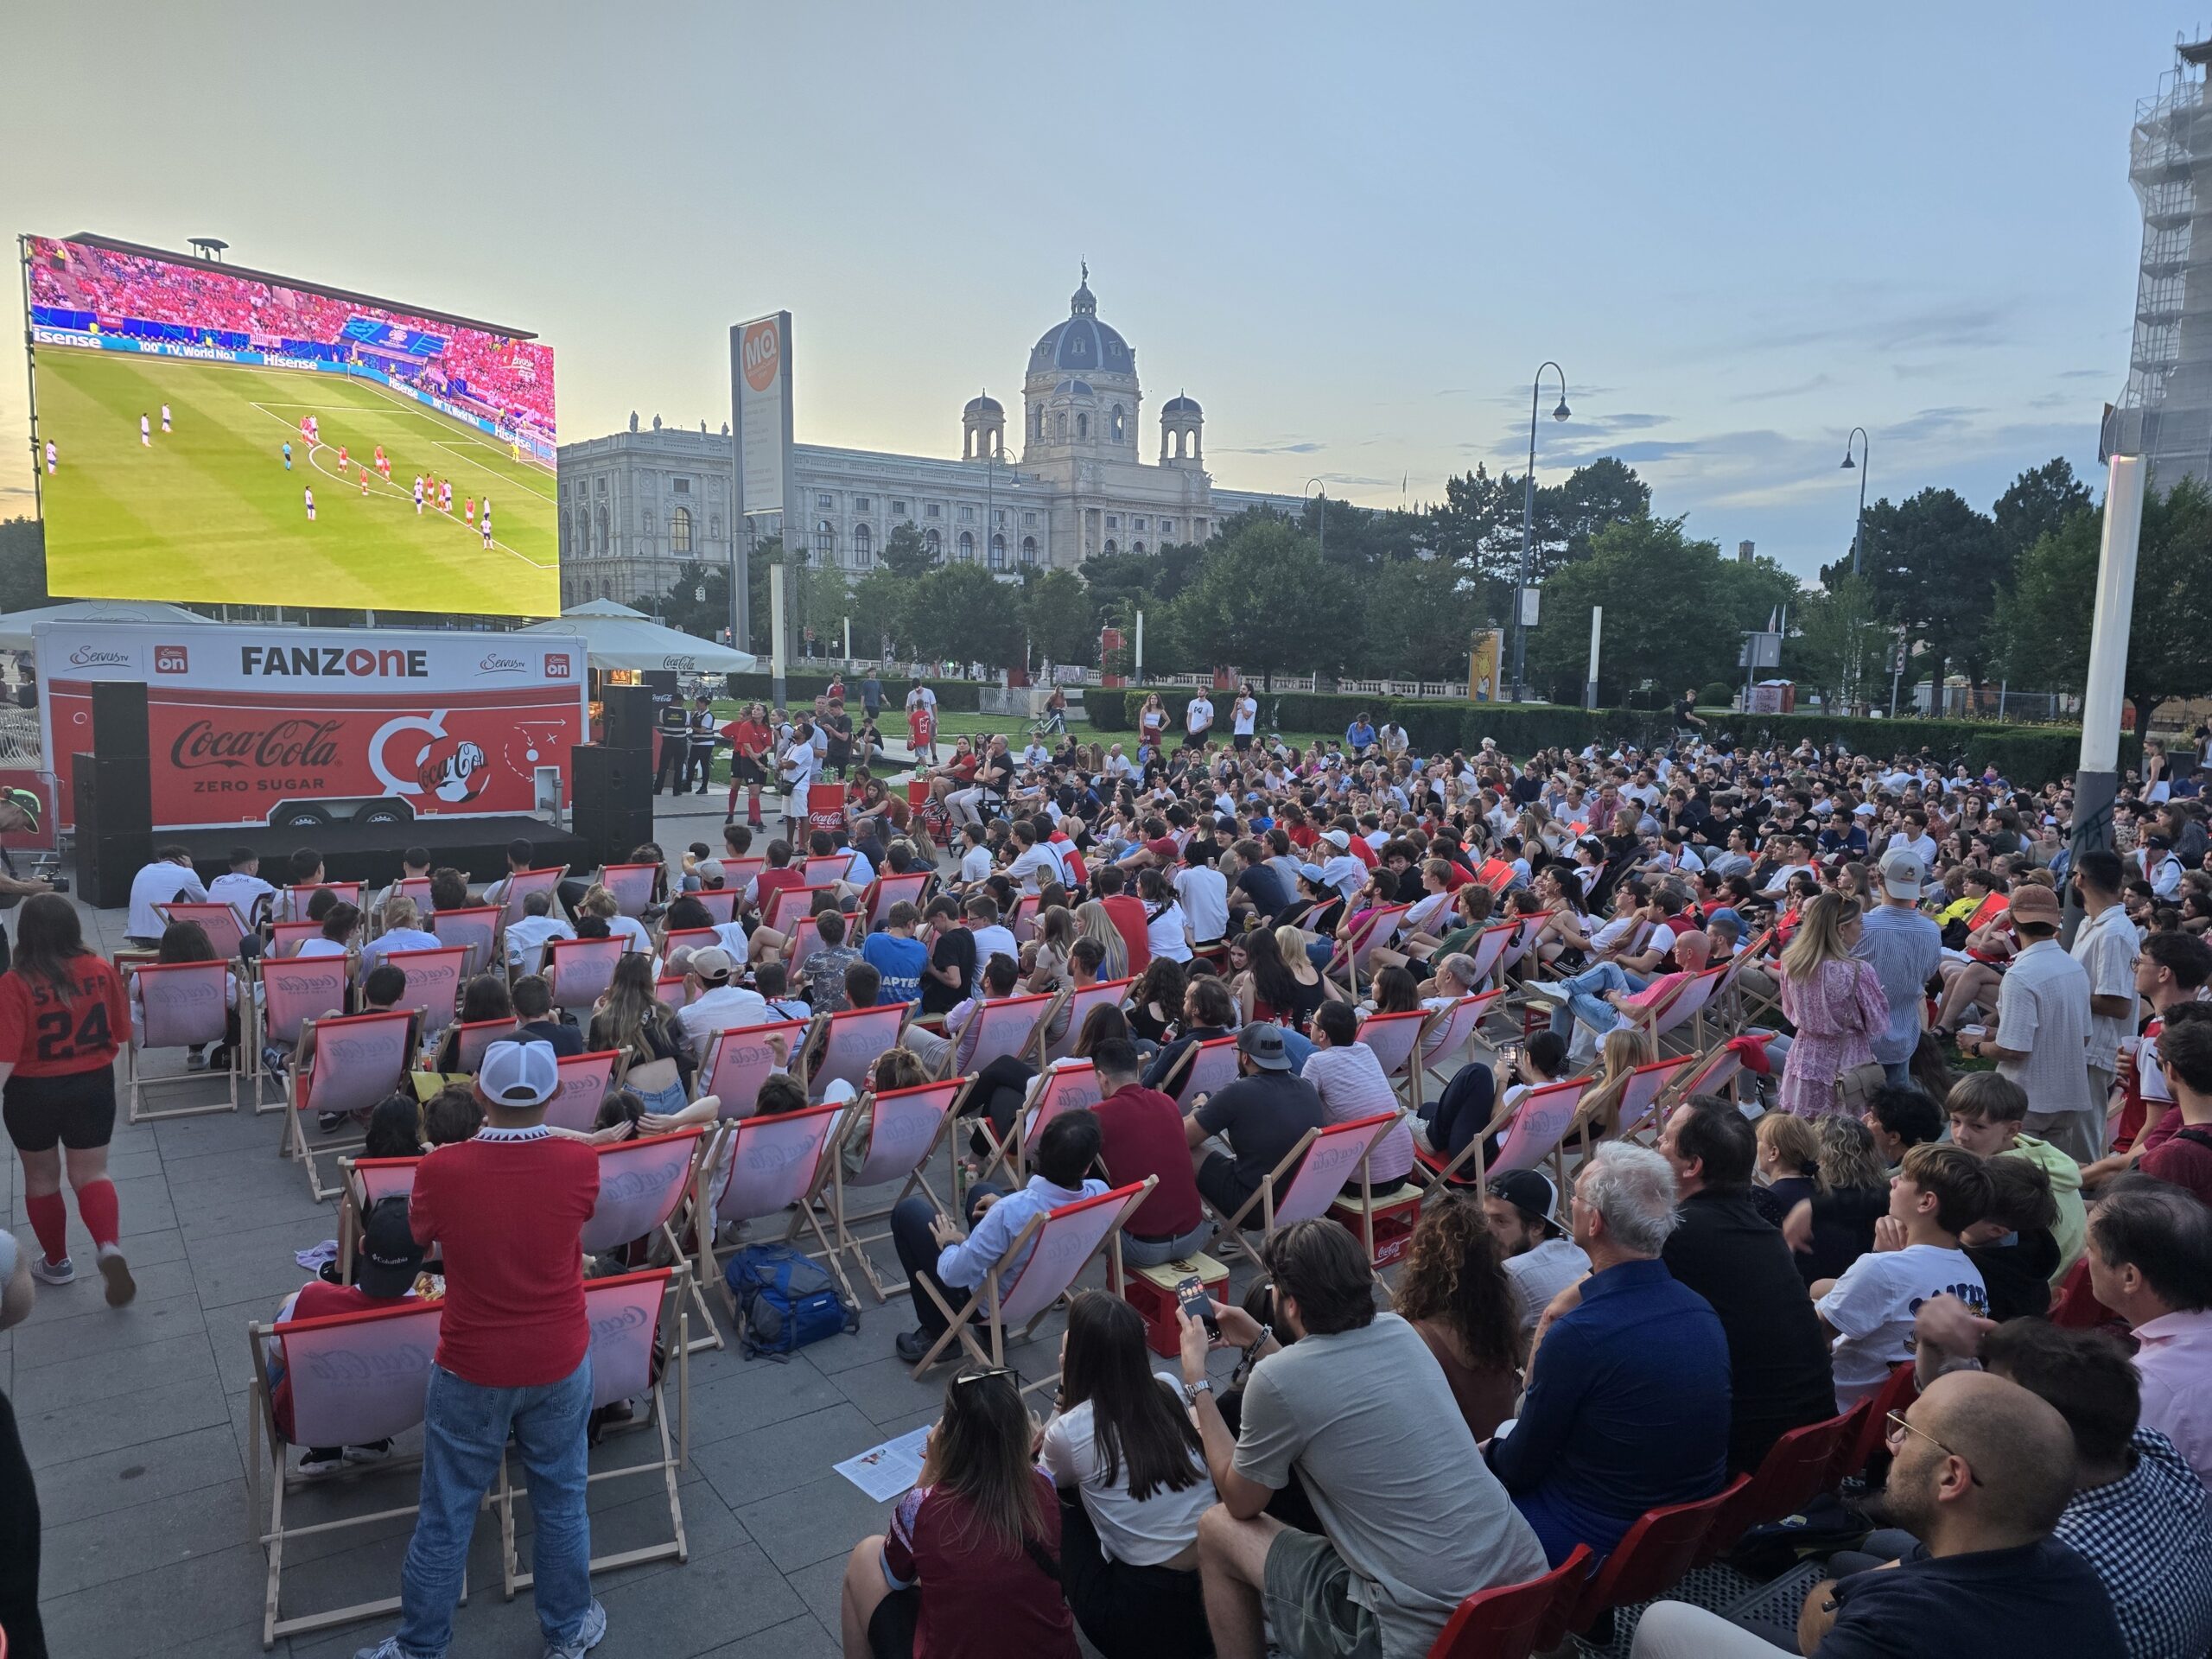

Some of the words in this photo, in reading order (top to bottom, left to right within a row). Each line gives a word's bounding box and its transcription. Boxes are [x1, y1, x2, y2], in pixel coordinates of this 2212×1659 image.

[182, 346, 215, 359] World
[216, 348, 236, 360] No.1
[746, 328, 777, 370] MQ
[263, 354, 318, 370] Hisense
[388, 377, 418, 399] Hisense
[494, 425, 532, 451] Hisense
[158, 657, 185, 671] on
[547, 664, 568, 675] on
[663, 656, 696, 671] Coca-Cola
[171, 719, 346, 769] Coca-Cola
[194, 780, 250, 794] ZERO
[257, 778, 325, 791] SUGAR
[810, 812, 842, 826] Coca-Cola
[37, 1002, 111, 1061] 24
[377, 1256, 408, 1265] Columbia
